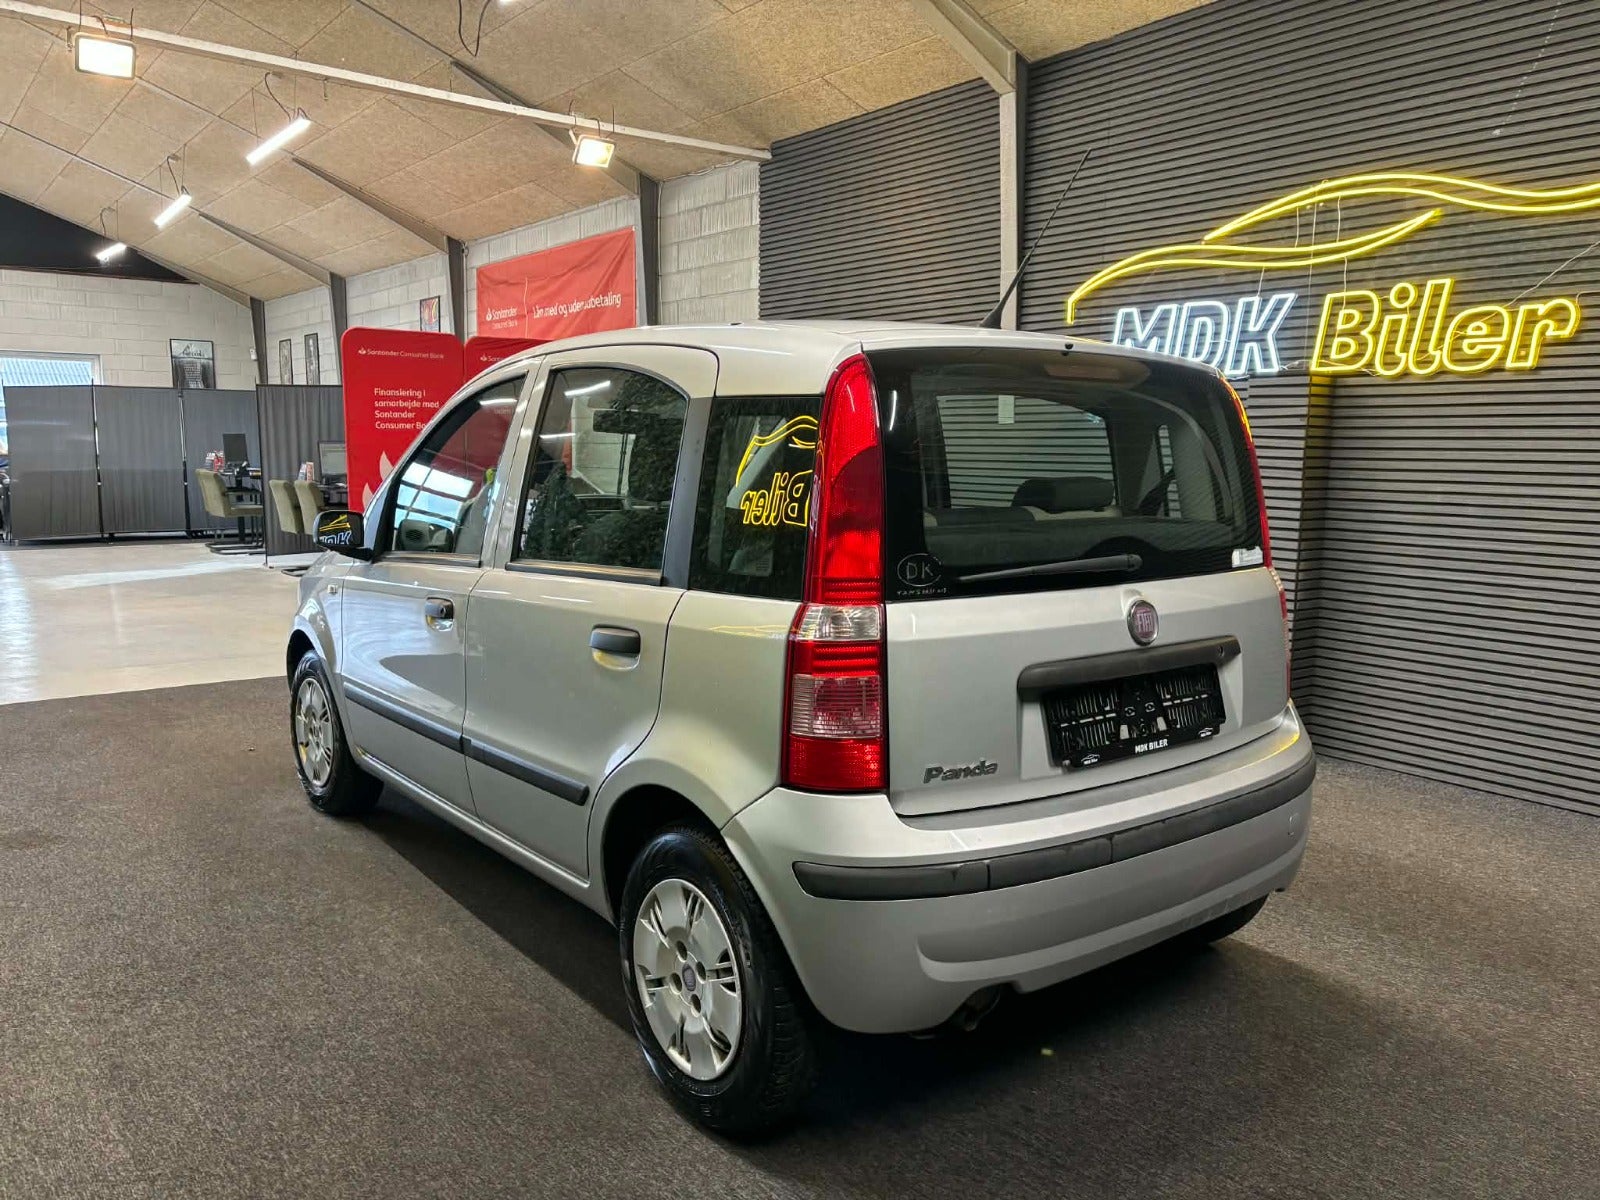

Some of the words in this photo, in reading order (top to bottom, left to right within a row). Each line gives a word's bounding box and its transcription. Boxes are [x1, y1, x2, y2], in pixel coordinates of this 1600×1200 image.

[558, 304, 567, 317] og
[1112, 292, 1297, 376] MDK
[1310, 277, 1580, 377] Biler
[367, 348, 399, 356] Santander
[400, 350, 428, 358] Consumer
[374, 388, 422, 399] Finansiering
[423, 389, 426, 397] i
[374, 400, 421, 409] samarbejde
[374, 410, 416, 418] Santander
[375, 421, 415, 429] Consumer
[906, 561, 934, 580] DK
[1135, 743, 1148, 753] MDK
[1149, 738, 1168, 750] BILER
[923, 760, 998, 784] Panda
